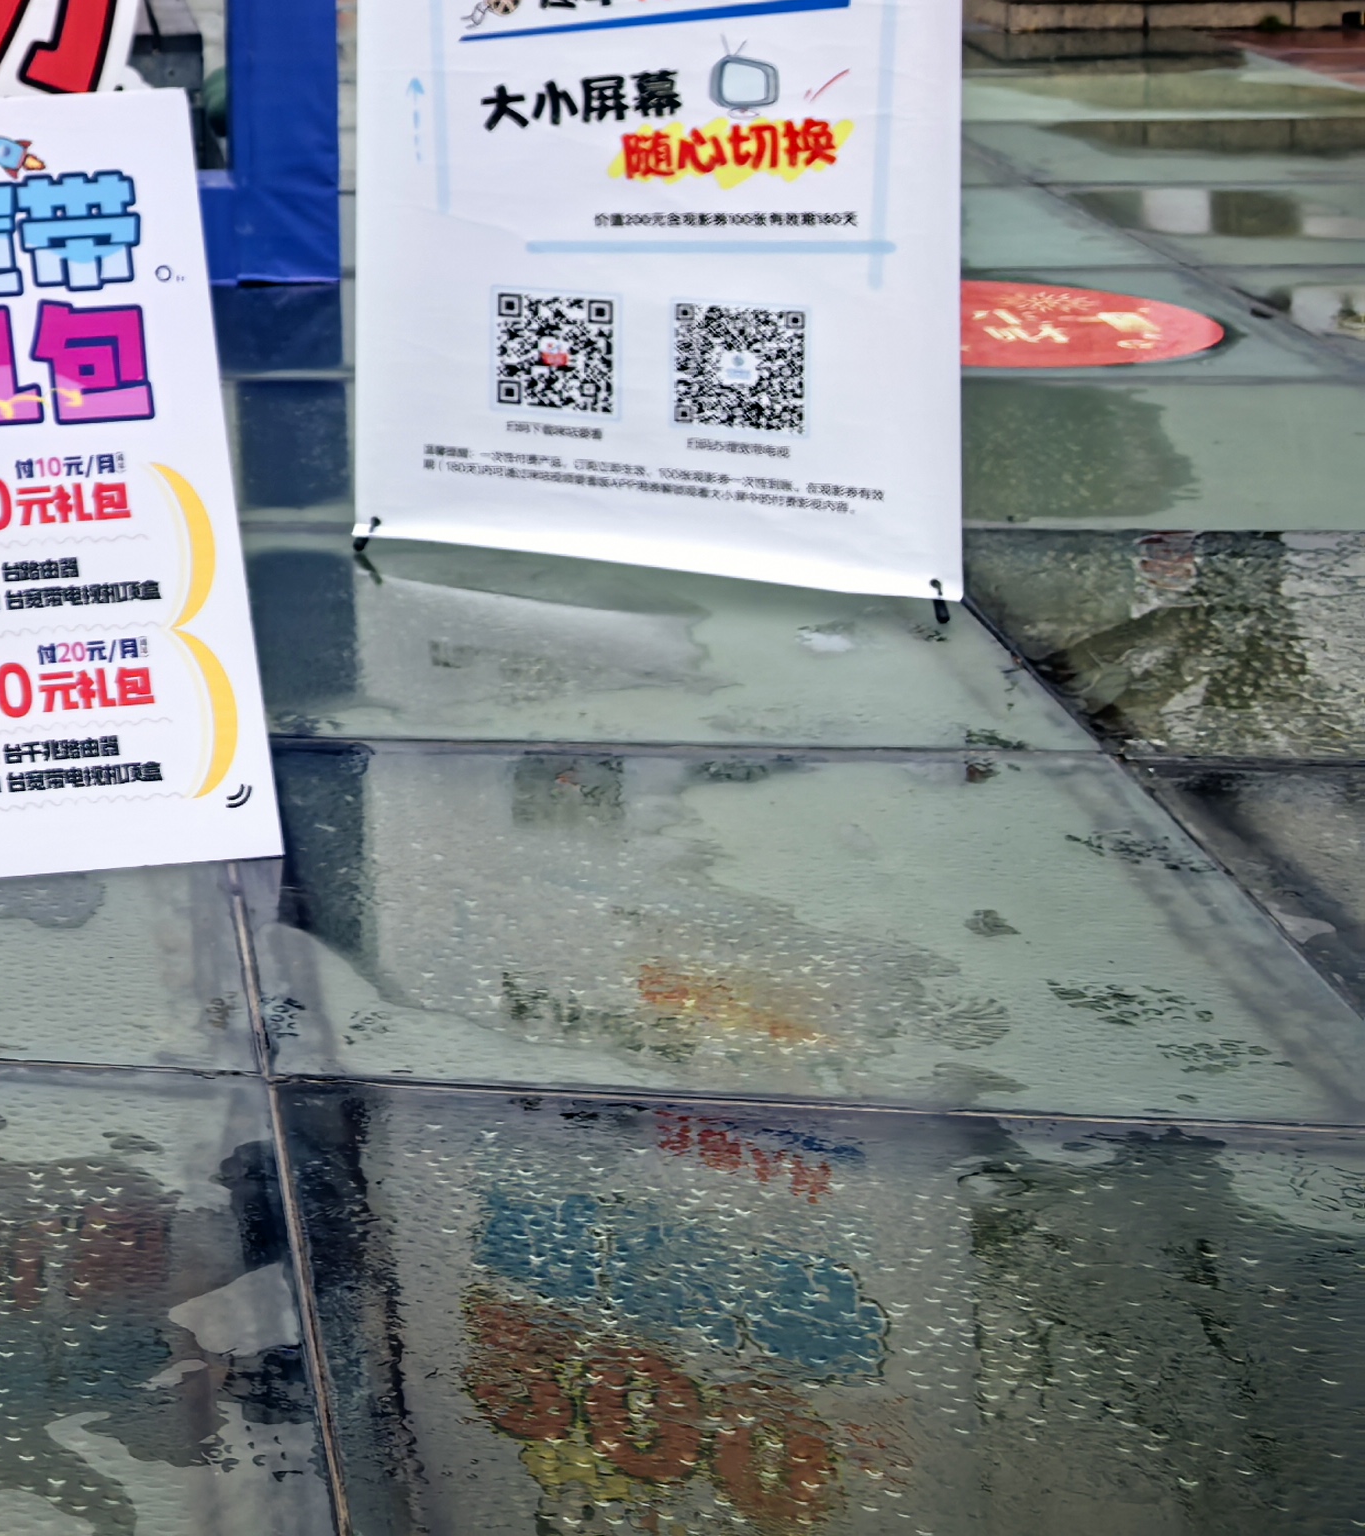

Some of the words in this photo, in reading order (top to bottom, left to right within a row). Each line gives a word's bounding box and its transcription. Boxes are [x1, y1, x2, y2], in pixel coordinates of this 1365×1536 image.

[480, 68, 683, 132] 大小屏幕
[621, 116, 839, 180] 随心切换
